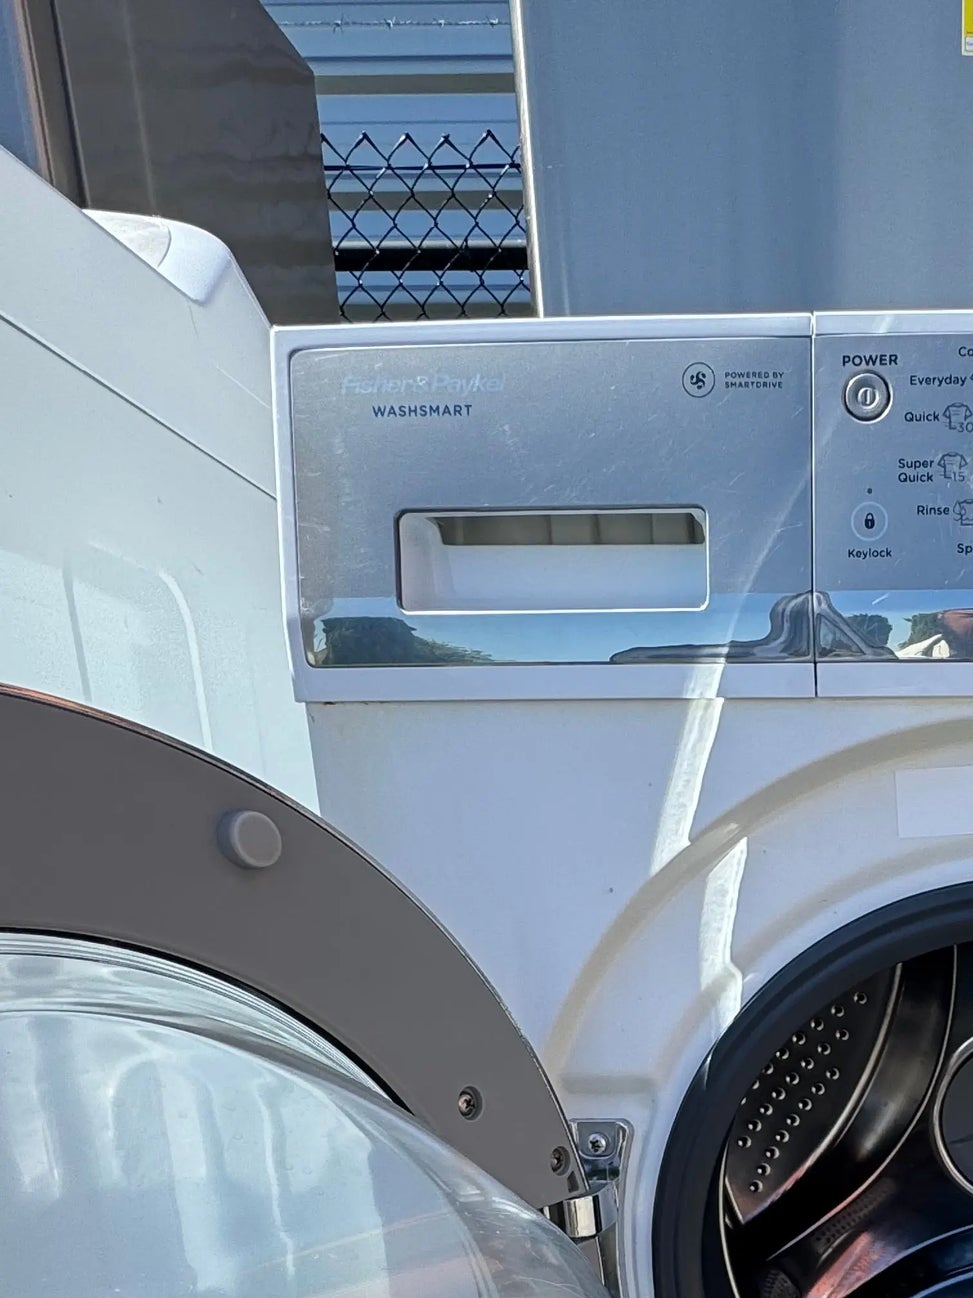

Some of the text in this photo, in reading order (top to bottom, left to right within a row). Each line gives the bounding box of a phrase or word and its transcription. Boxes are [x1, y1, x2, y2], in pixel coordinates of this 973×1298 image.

[842, 354, 898, 366] POWER
[724, 371, 784, 379] POWERED BY
[724, 381, 783, 389] SMARTDRIVE
[910, 375, 967, 387] Everyday
[372, 404, 472, 418] WASHSMART
[904, 412, 940, 423] Quick
[957, 422, 973, 433] 30
[898, 459, 934, 471] Super
[898, 472, 934, 483] Quick
[917, 505, 950, 516] Rinse
[848, 548, 892, 560] Keylock
